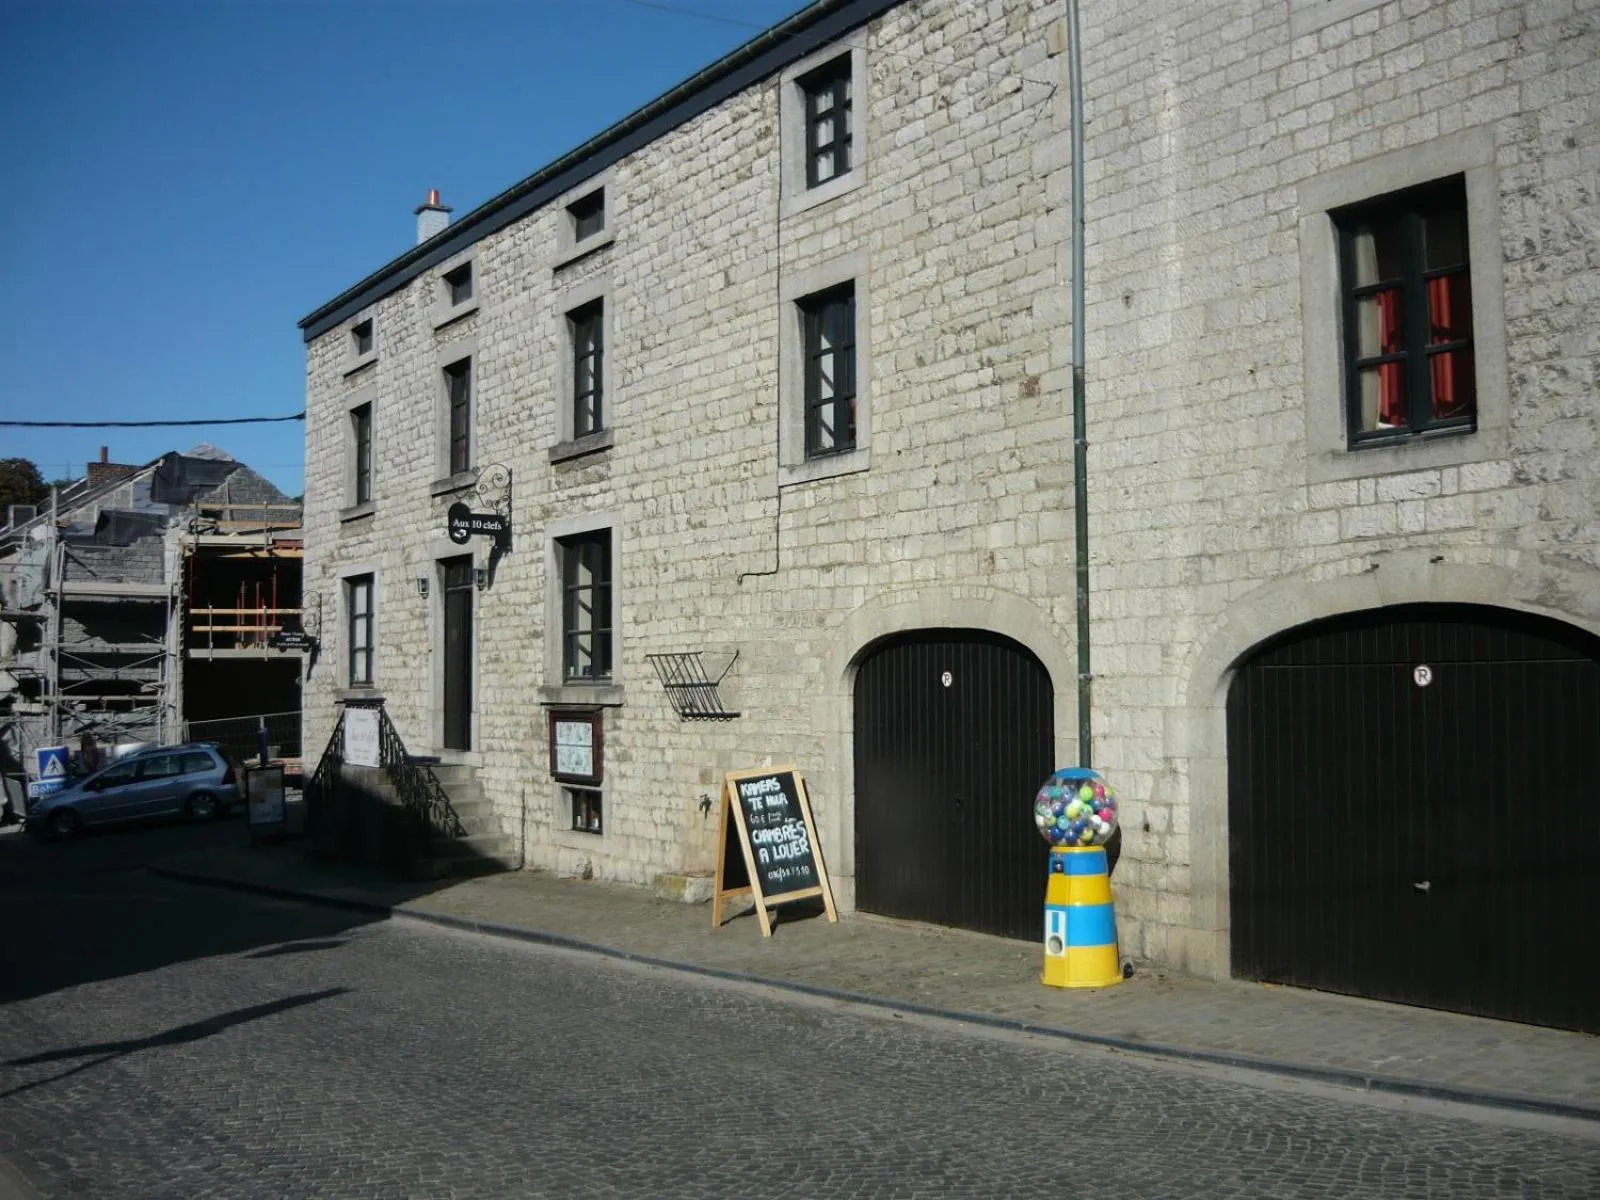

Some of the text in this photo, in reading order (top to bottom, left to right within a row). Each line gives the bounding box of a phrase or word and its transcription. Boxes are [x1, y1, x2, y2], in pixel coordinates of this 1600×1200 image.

[453, 519, 502, 530] Aux 10 clefs
[740, 778, 781, 796] KAMERS
[748, 797, 763, 811] TE
[752, 821, 806, 843] CHAMBRES
[759, 838, 809, 864] A LOUER
